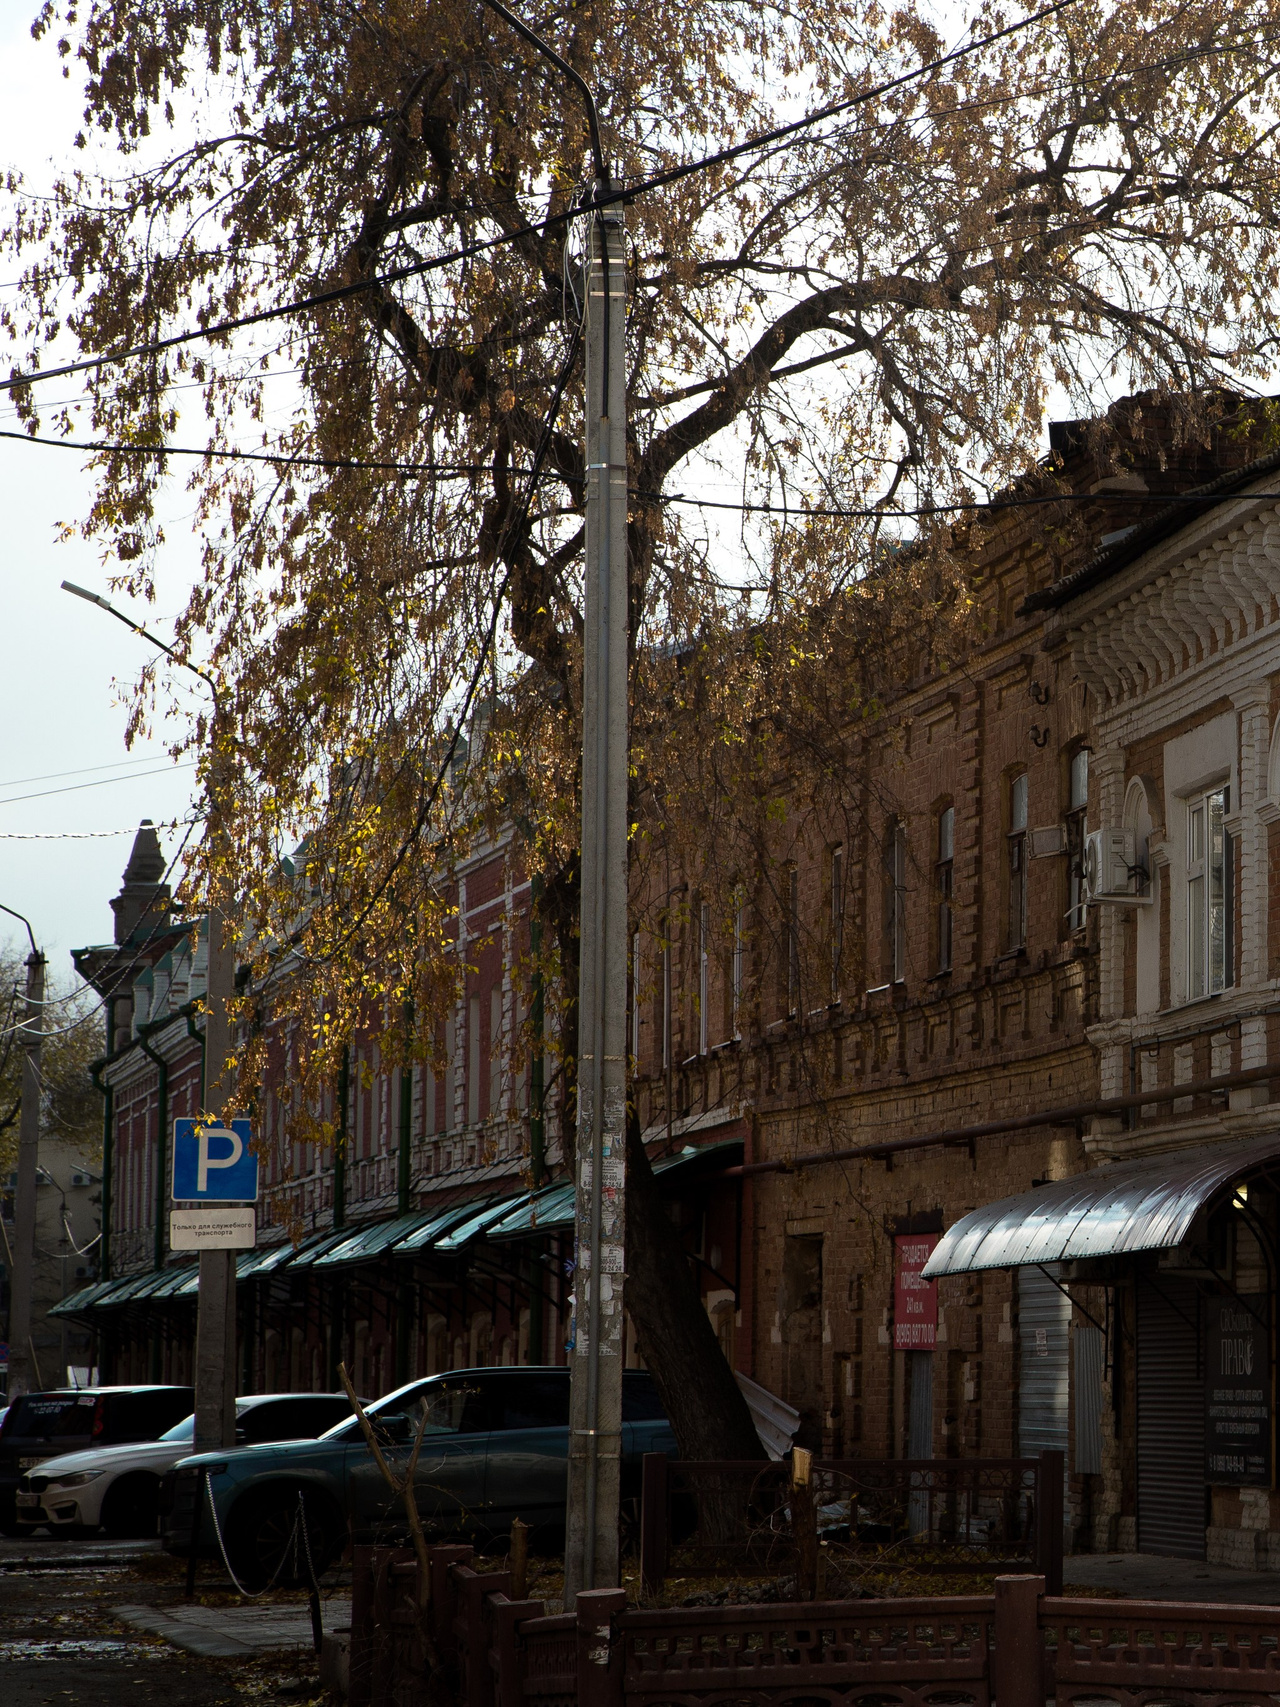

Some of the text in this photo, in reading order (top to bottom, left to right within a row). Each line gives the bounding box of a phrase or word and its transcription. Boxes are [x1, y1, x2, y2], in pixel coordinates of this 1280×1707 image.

[197, 1128, 243, 1192] P
[195, 1230, 233, 1238] транспорта
[198, 1223, 211, 1231] для
[212, 1221, 252, 1231] служебного
[902, 1244, 929, 1266] ПРОДАЕТСЯ
[1220, 1337, 1254, 1376] ПРАВО
